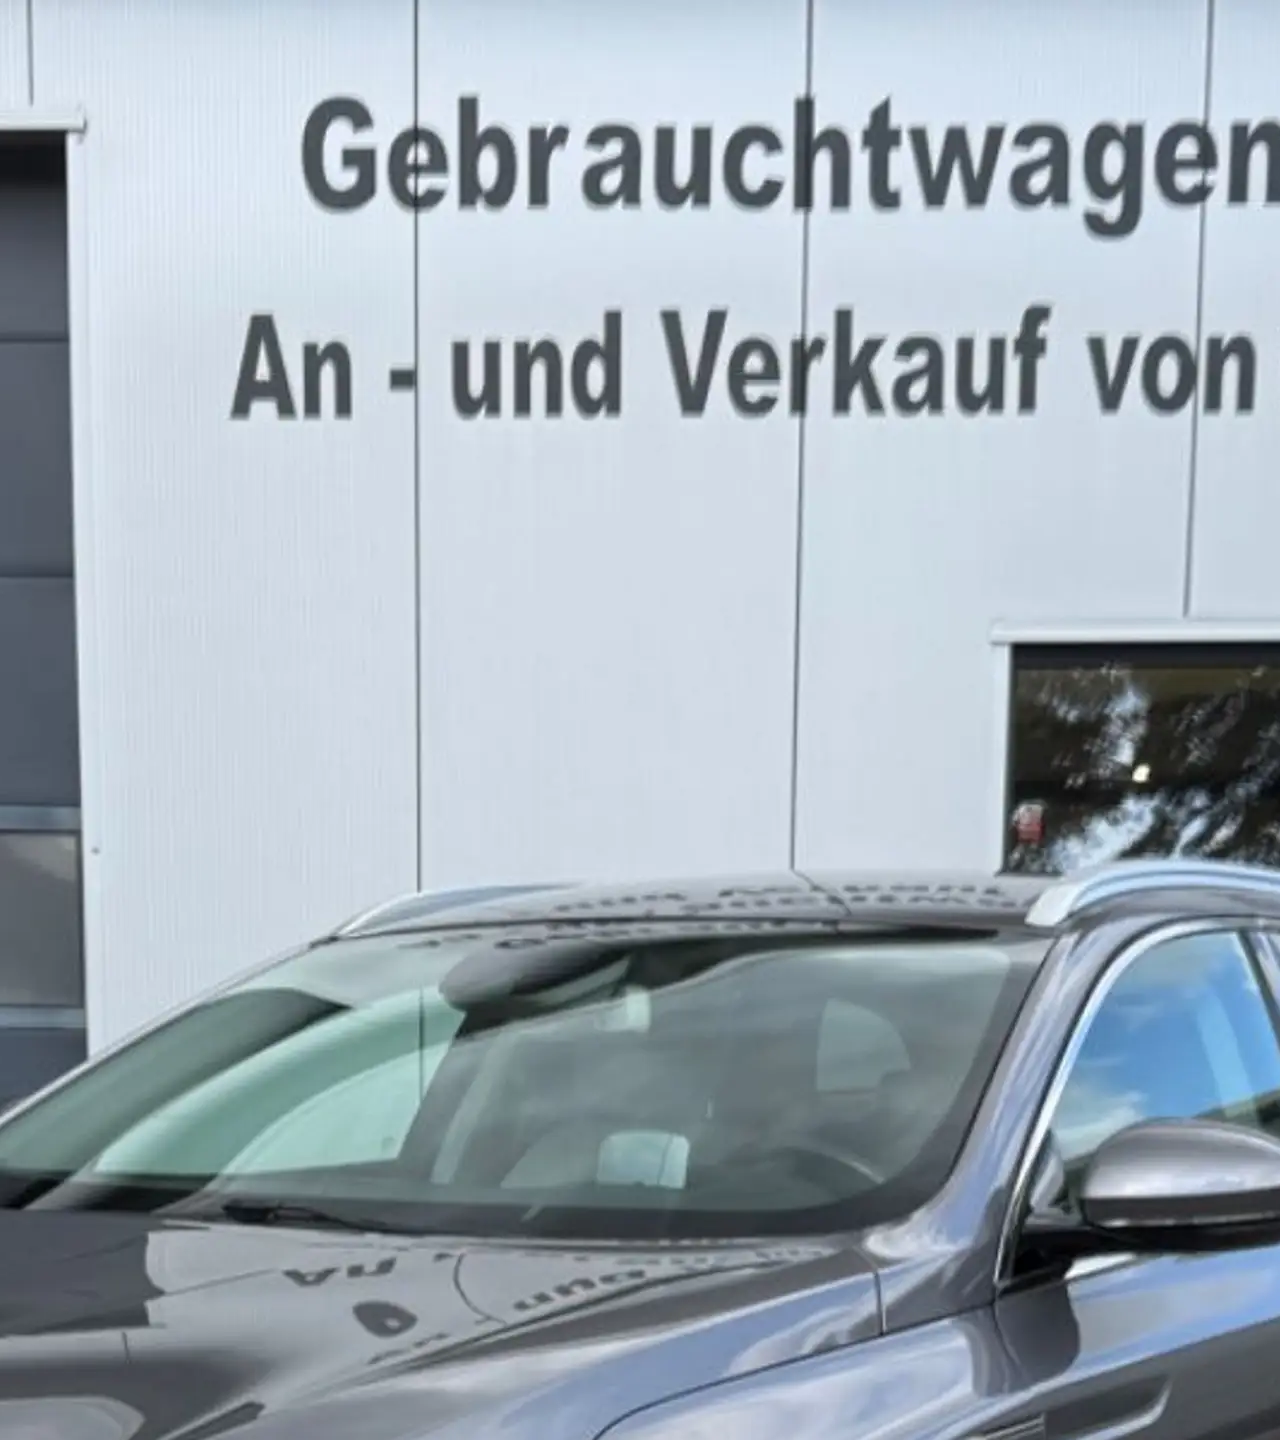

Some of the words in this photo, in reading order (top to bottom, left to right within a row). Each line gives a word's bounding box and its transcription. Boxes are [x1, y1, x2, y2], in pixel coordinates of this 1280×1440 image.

[230, 313, 354, 420] An
[450, 310, 622, 419] und
[660, 303, 1052, 419] Verkauf
[1088, 329, 1257, 415] von
